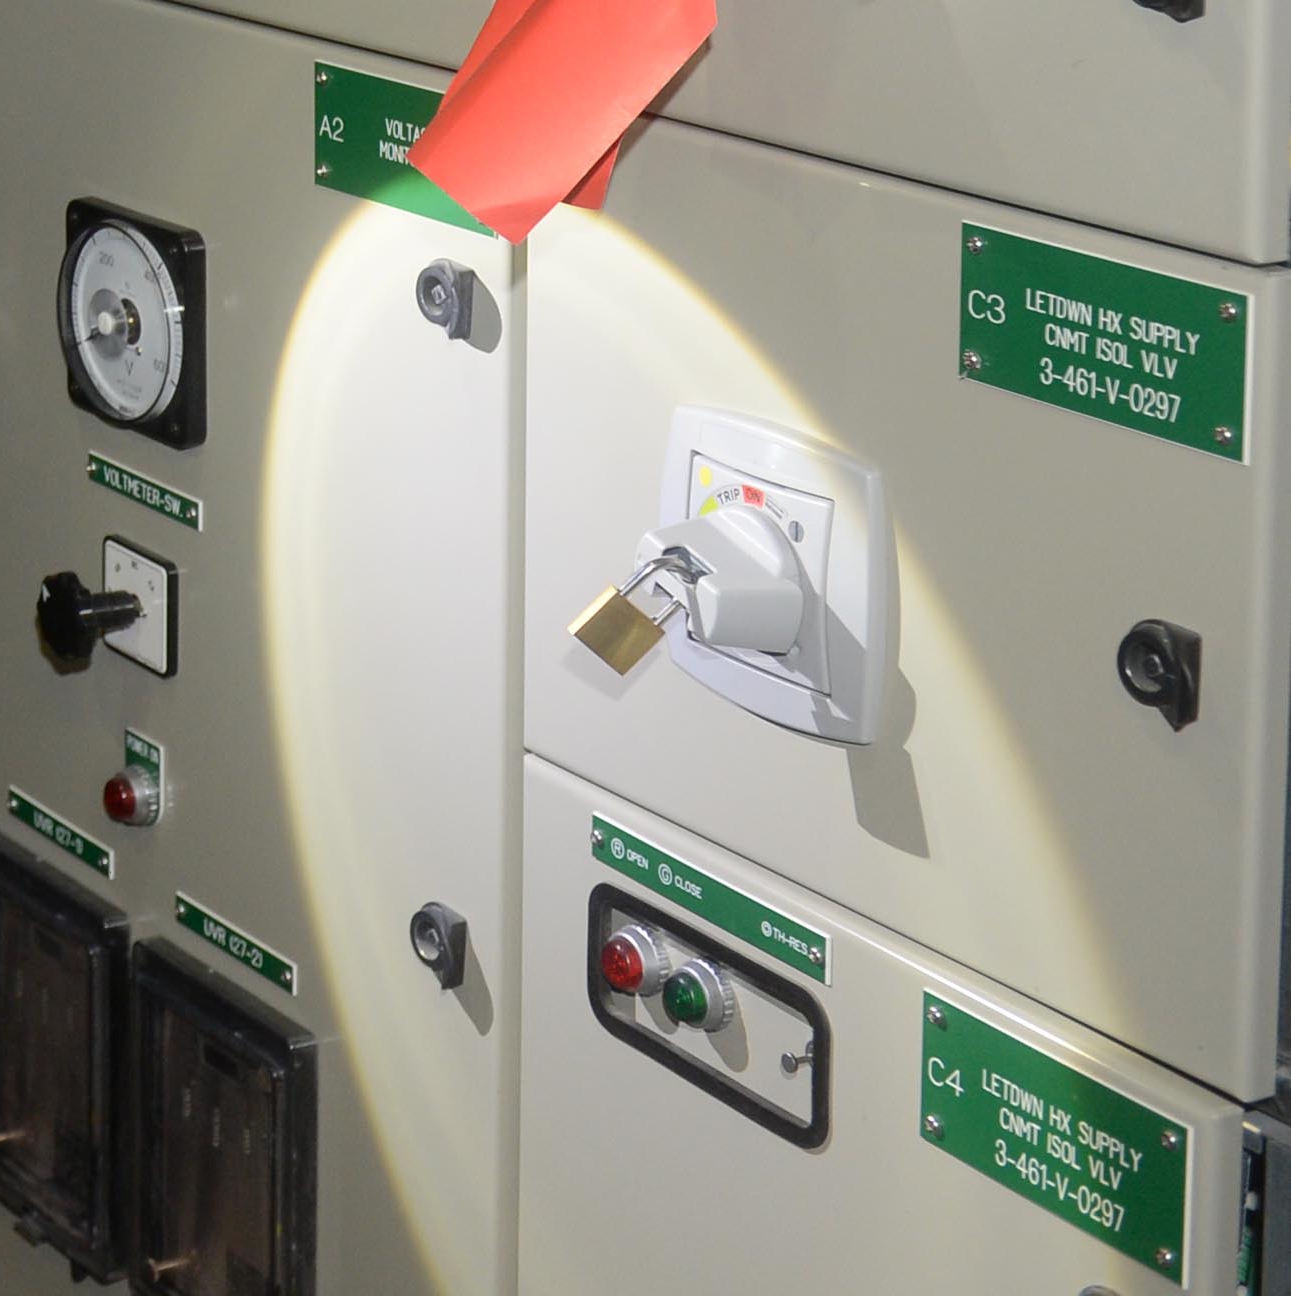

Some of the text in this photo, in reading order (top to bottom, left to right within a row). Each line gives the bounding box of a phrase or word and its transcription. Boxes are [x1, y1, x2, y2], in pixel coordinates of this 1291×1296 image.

[319, 114, 344, 143] A2
[968, 289, 1005, 324] C3
[1025, 288, 1200, 355] LETDWN HX SUPPLY
[1044, 323, 1177, 380] CNMT ISOL VLV
[1039, 358, 1181, 423] 3-461-V-0297
[103, 464, 183, 518] VOLTMETER-SW.
[717, 487, 761, 505] TRIP ON
[626, 849, 649, 870] OPEN
[674, 875, 703, 900] CLOSE
[203, 917, 226, 946] UVR
[927, 1057, 964, 1097] C4
[982, 1068, 1143, 1173] LETDWN HX SUPPLY
[999, 1107, 1122, 1191] CNMT ISOL VLV
[995, 1139, 1125, 1232] 3-461-V-0297
